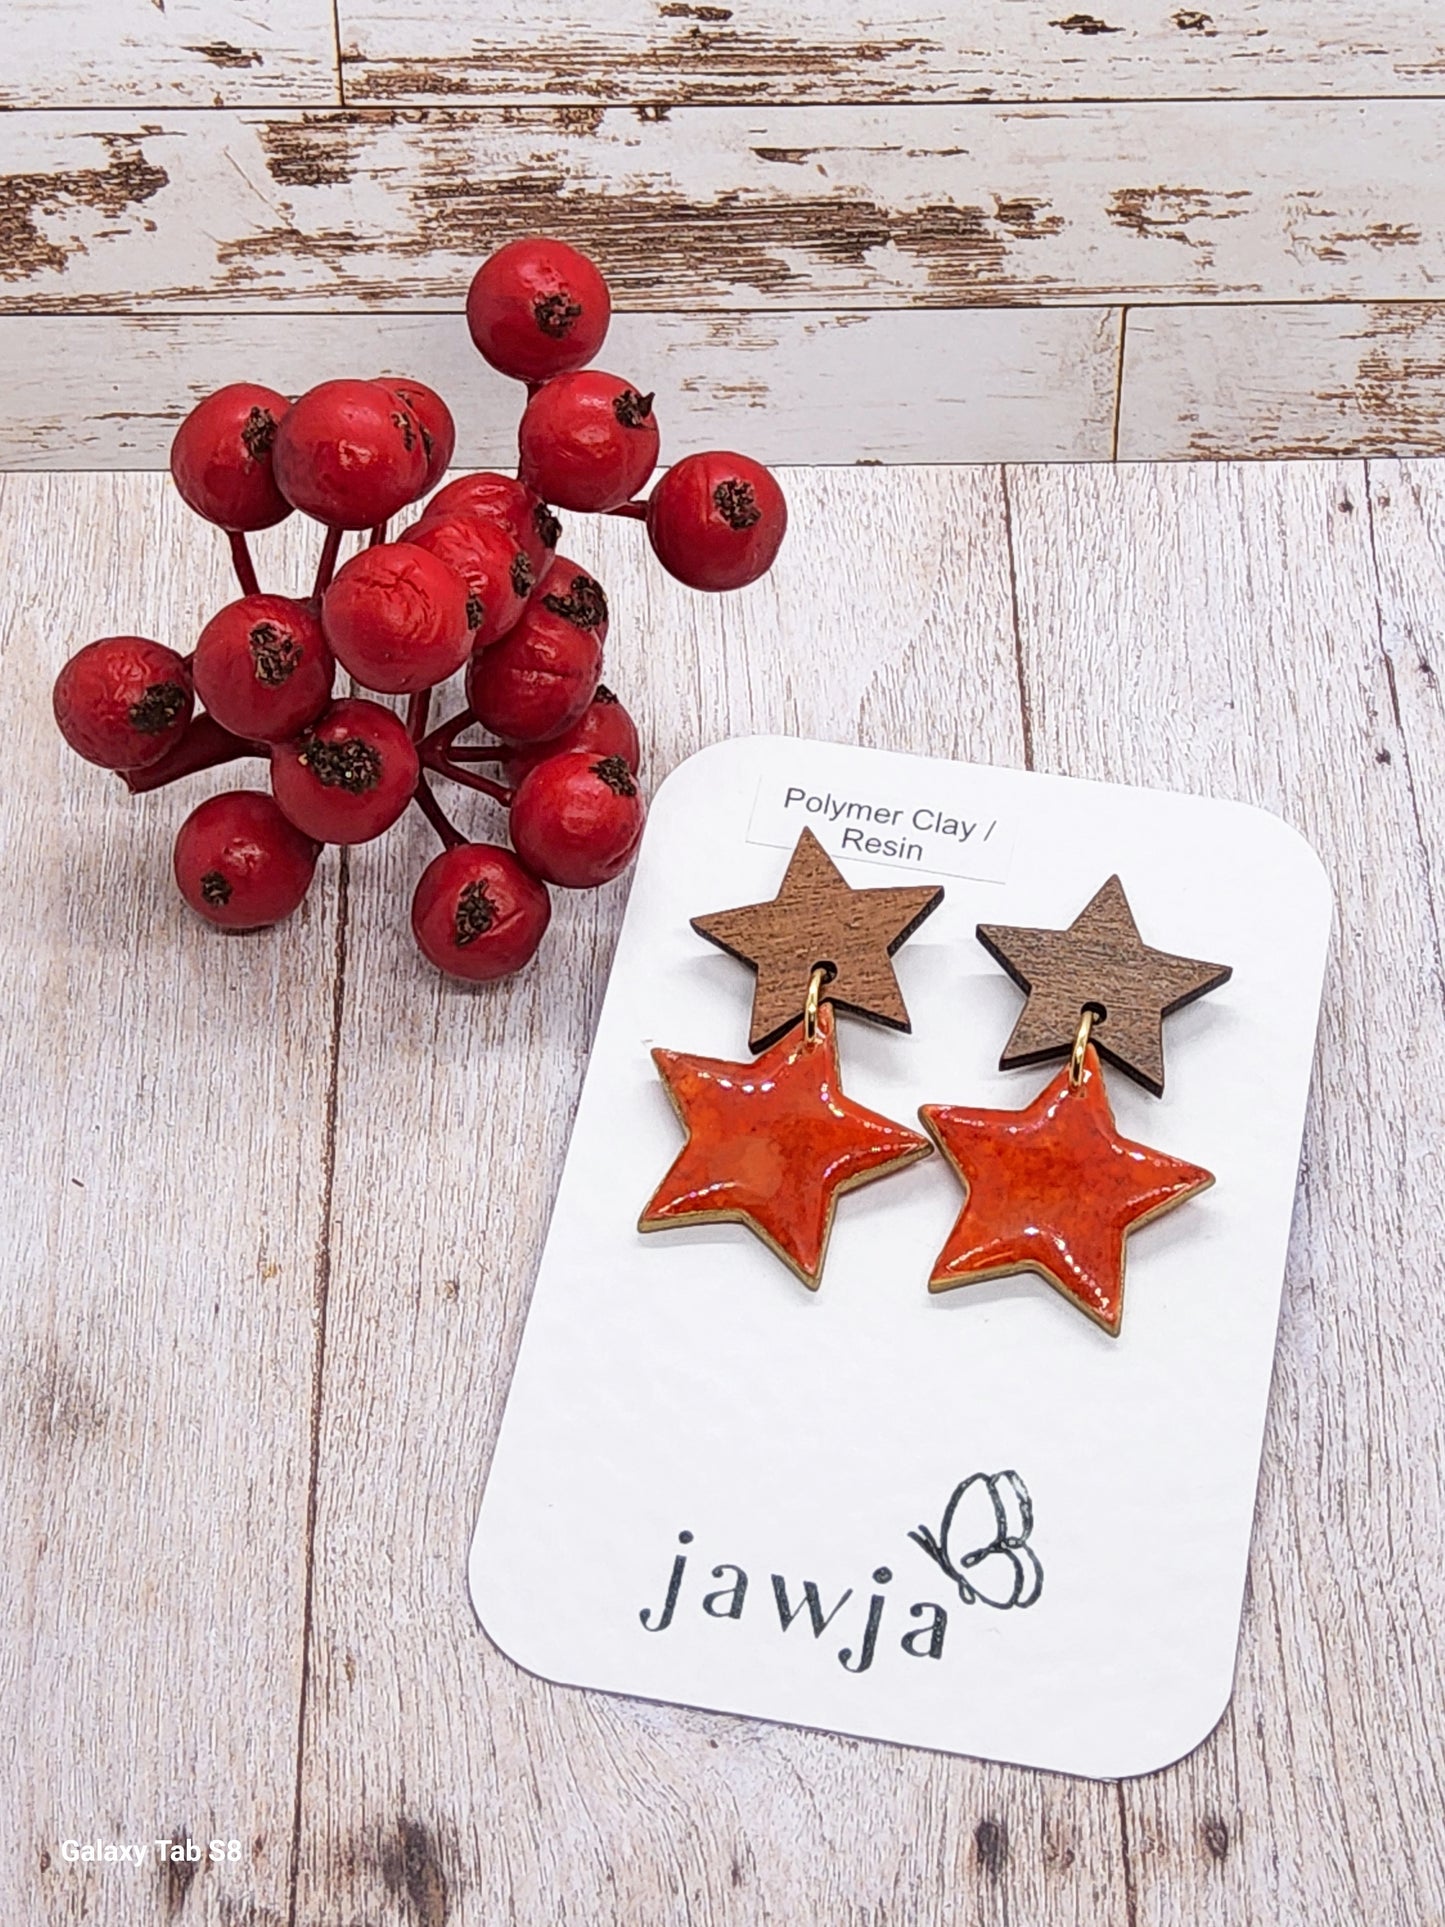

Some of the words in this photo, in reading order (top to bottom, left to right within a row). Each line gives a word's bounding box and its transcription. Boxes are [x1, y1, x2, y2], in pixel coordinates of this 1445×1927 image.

[784, 787, 903, 826] Polymer
[911, 808, 977, 843] Clay
[841, 827, 924, 862] Resin
[639, 1530, 948, 1673] jawja
